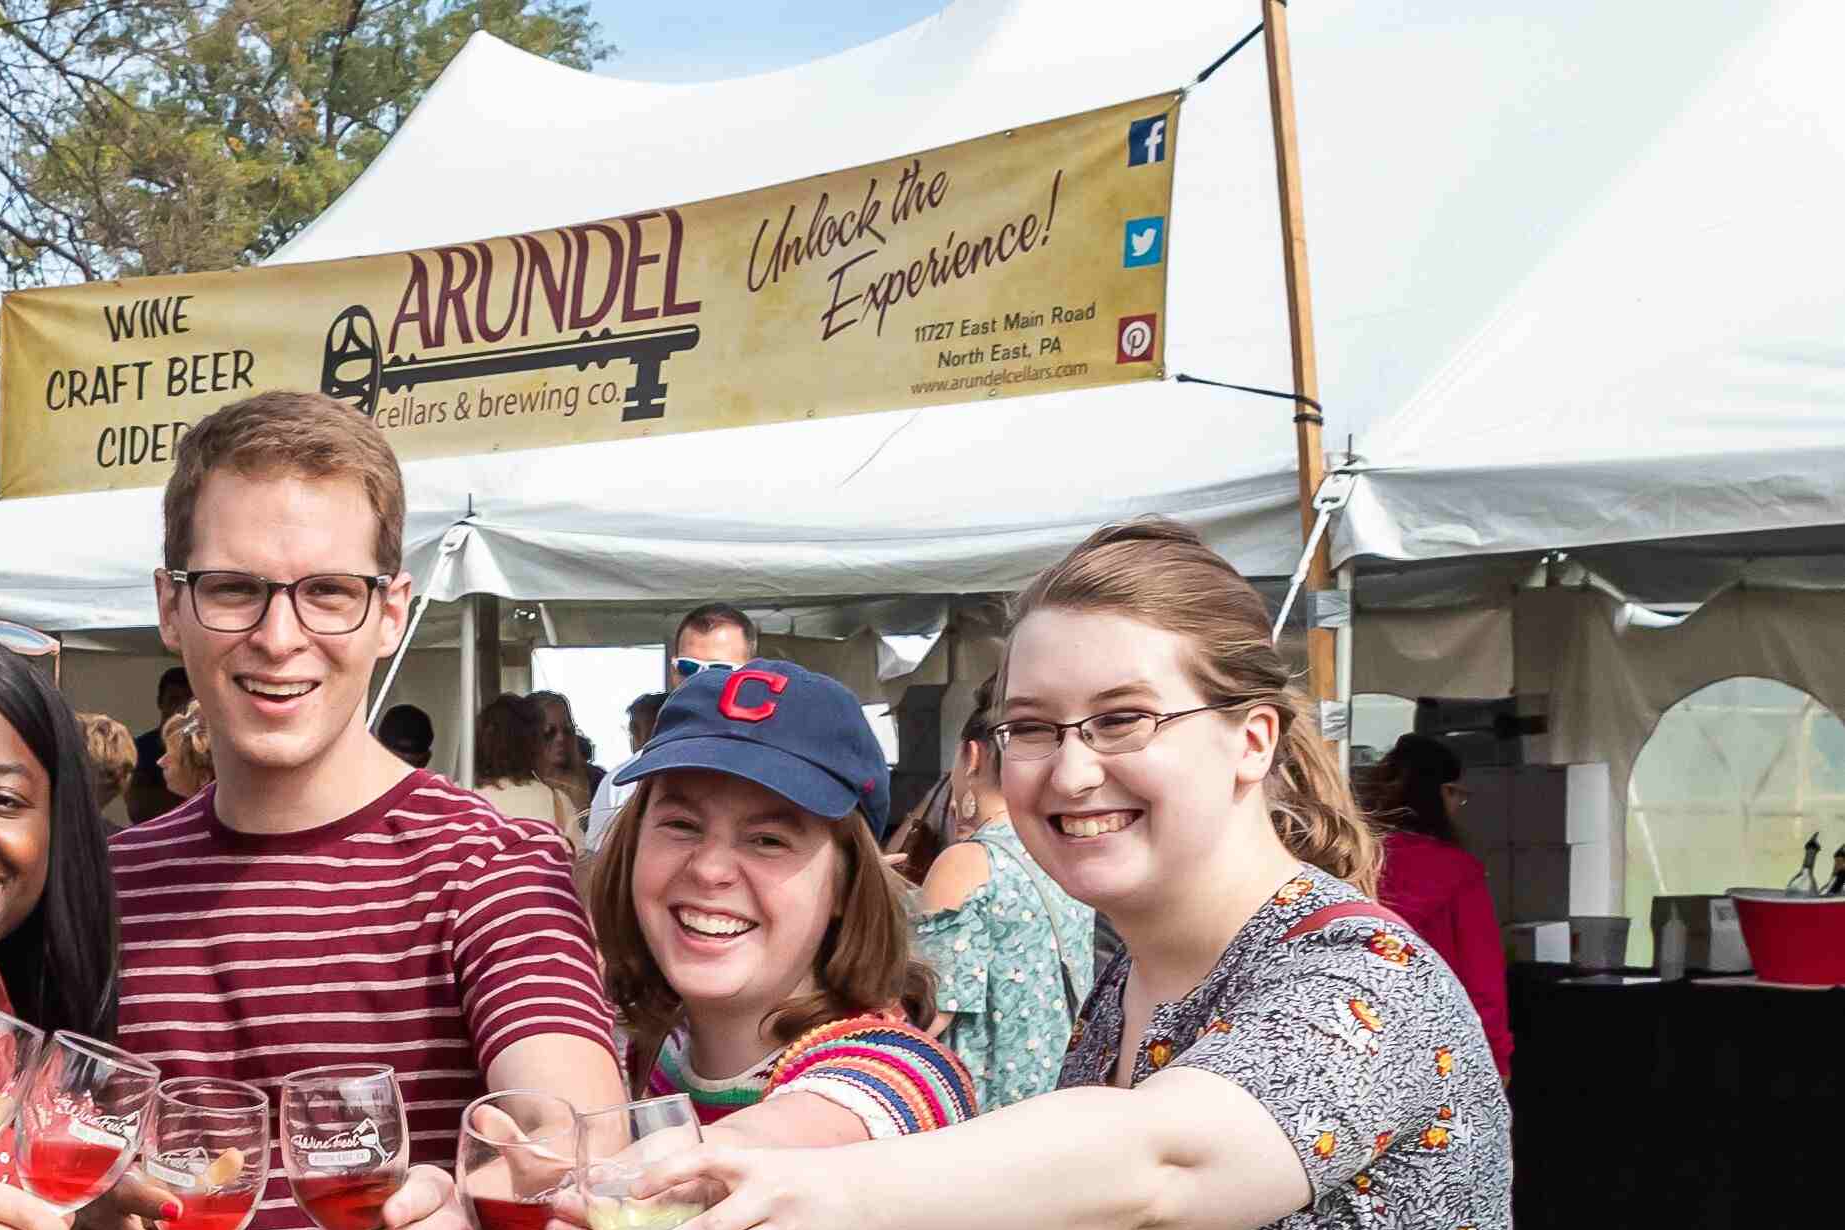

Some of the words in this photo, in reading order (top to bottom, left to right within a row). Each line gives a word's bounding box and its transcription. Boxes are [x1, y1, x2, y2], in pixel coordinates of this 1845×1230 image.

[747, 178, 887, 293] Unlock
[891, 159, 948, 225] the
[821, 168, 1063, 341] Experience!
[388, 208, 702, 354] ARUNDEL
[104, 295, 195, 342] WINE
[915, 322, 954, 343] 11727
[960, 317, 997, 338] East
[1003, 310, 1044, 331] Main
[1051, 302, 1097, 324] Road
[937, 347, 984, 368] North
[990, 343, 1032, 362] East,
[1039, 336, 1062, 356] PA
[46, 361, 153, 411] CRAFT
[167, 349, 255, 397] BEER
[910, 362, 1088, 395] www.arundelcellars.com
[376, 397, 447, 430] cellars
[454, 391, 471, 421] &
[478, 382, 580, 417] brewing
[587, 381, 621, 405] co.
[717, 670, 788, 722] C
